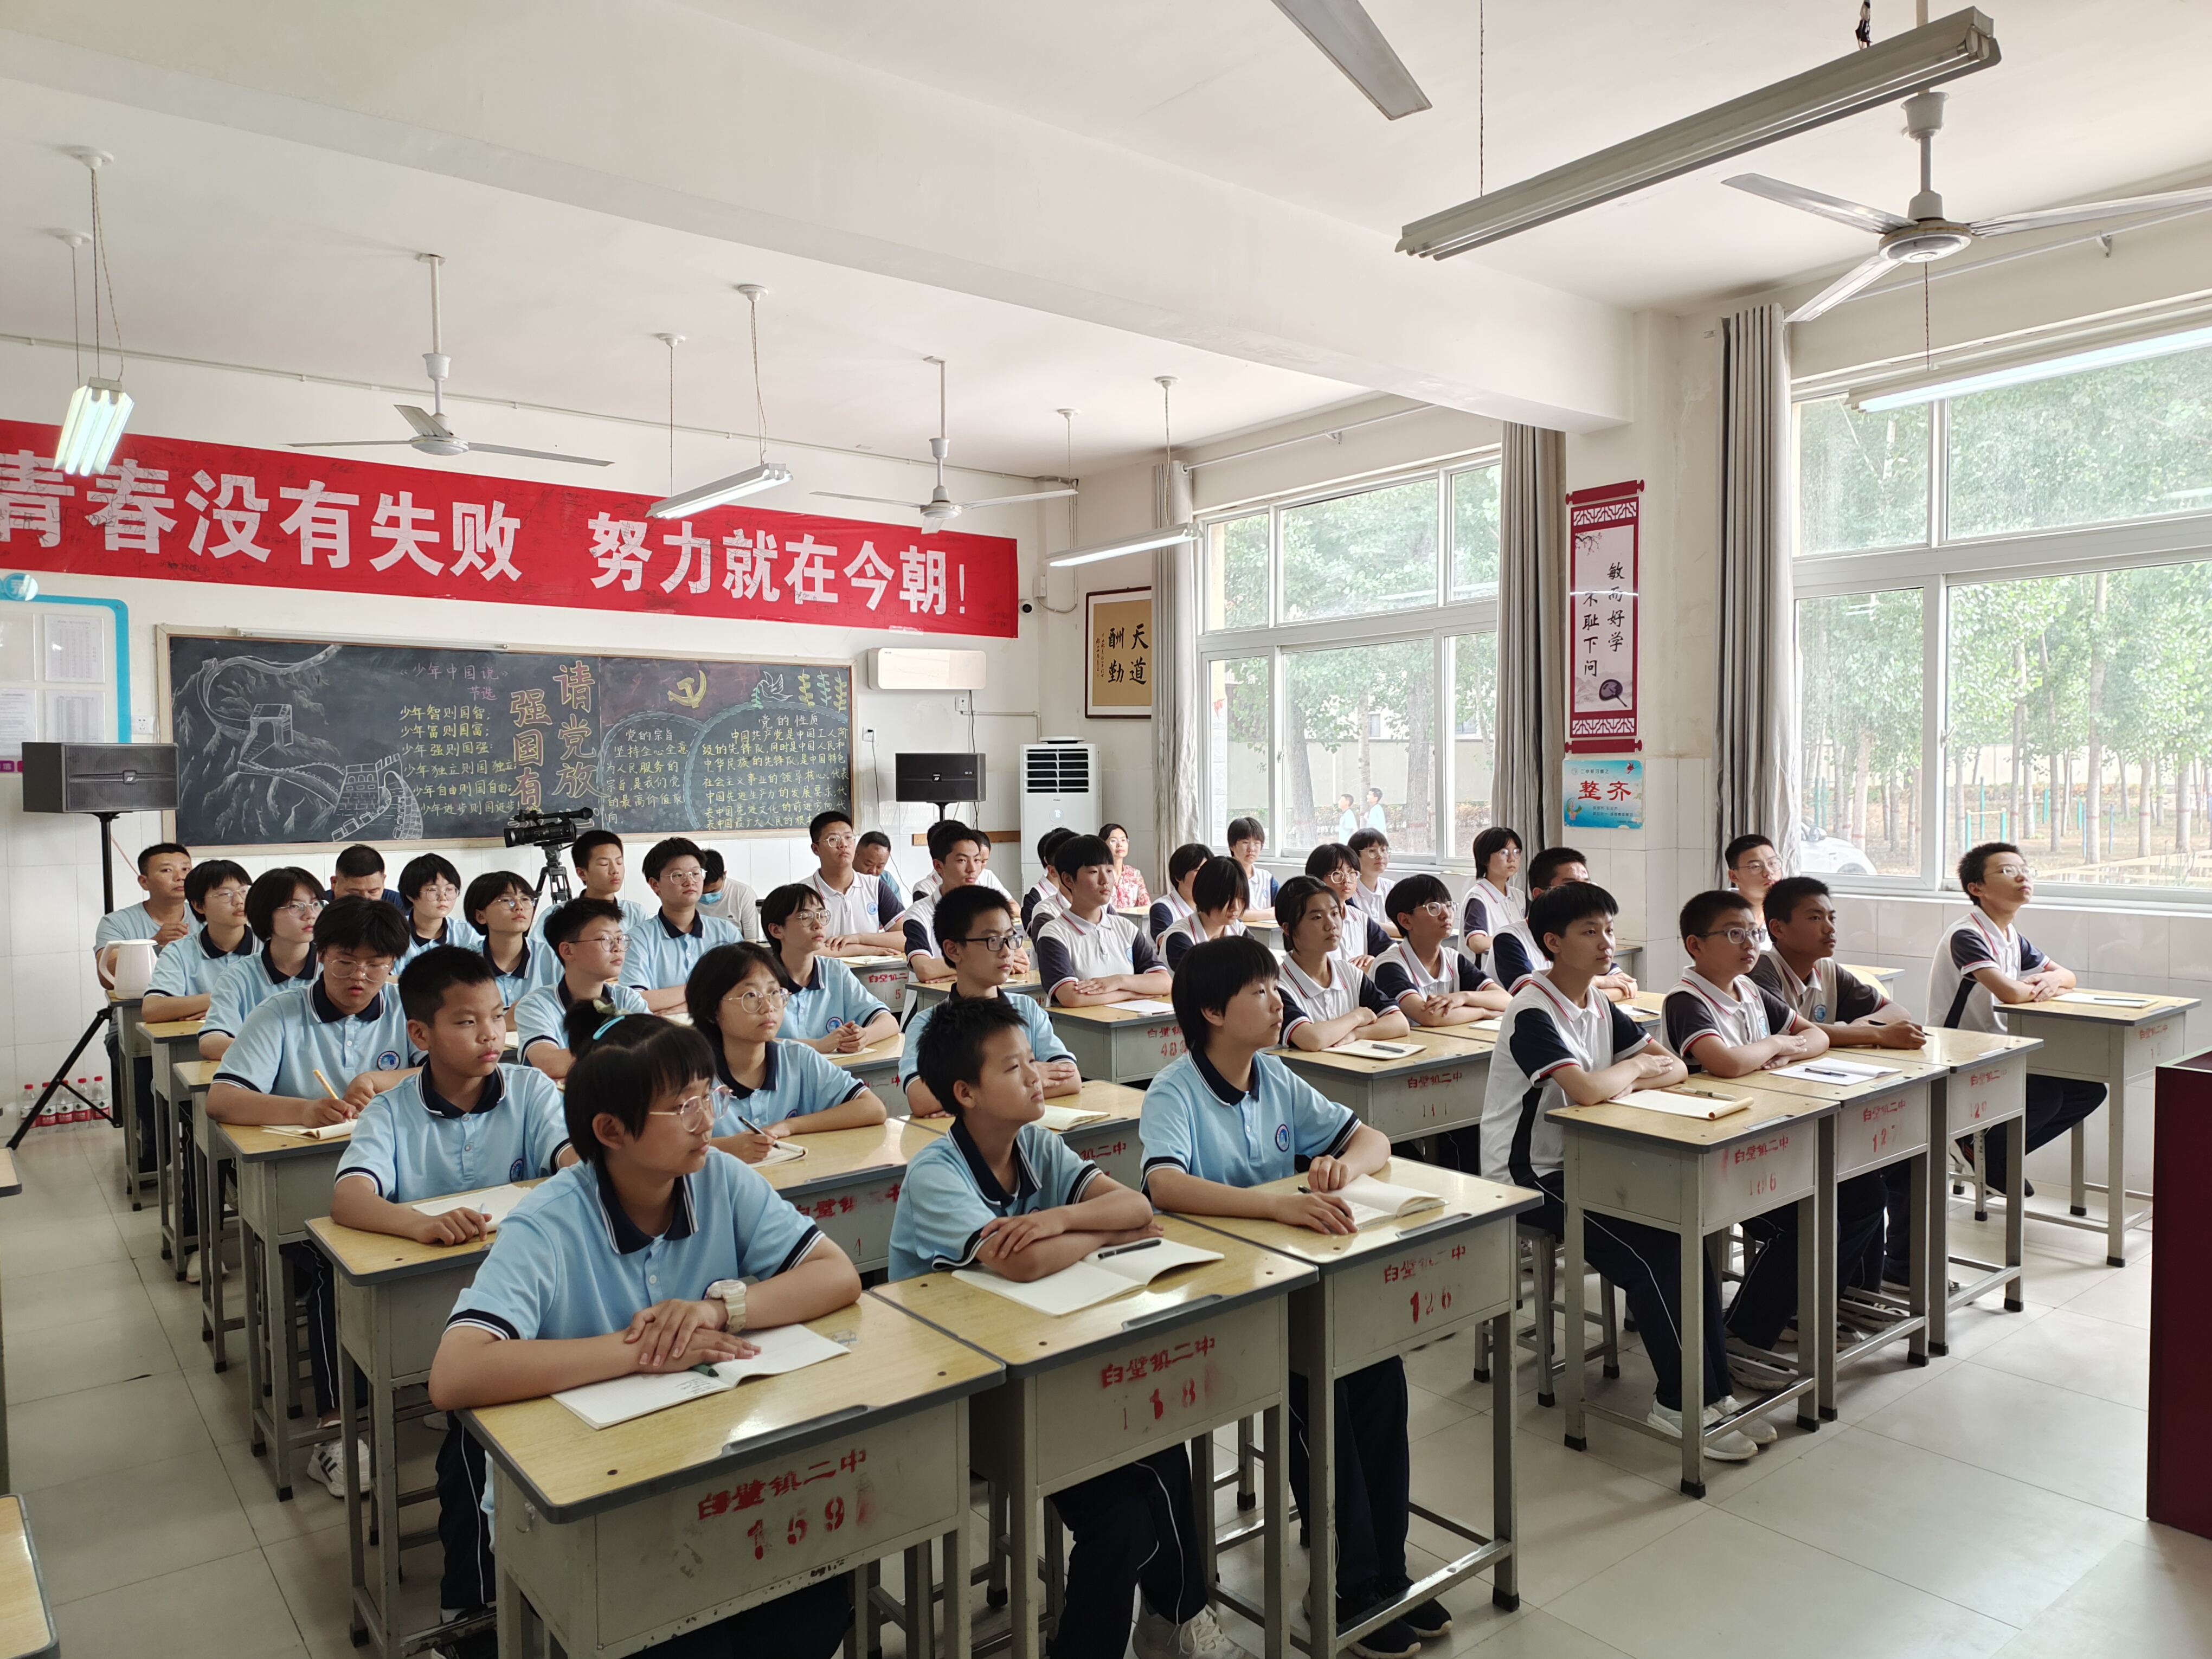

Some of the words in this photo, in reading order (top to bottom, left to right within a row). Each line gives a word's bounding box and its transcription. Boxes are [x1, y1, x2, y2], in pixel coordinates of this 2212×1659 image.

[0, 449, 522, 582] 青春没有失败
[587, 511, 966, 615] 努力就在今朝!
[1606, 562, 1625, 652] 敏而好学
[1582, 590, 1600, 677] 不耻下问
[1108, 627, 1125, 683] 酬勤
[1129, 623, 1149, 685] 天道
[400, 662, 509, 680] 《少年中国说》
[467, 685, 498, 702] 节选
[758, 712, 819, 730] 党的性质
[625, 728, 672, 742] 党的宗旨
[731, 728, 848, 745] 中国共产党是中国工人阶
[507, 688, 553, 828] 强国有
[614, 741, 689, 758] 坚持全心全意
[606, 760, 678, 775] 为人民服务的
[1578, 780, 1631, 801] 整齐
[607, 792, 684, 809] 的最高价值取
[706, 815, 821, 831] 表中国最广大人民的根本
